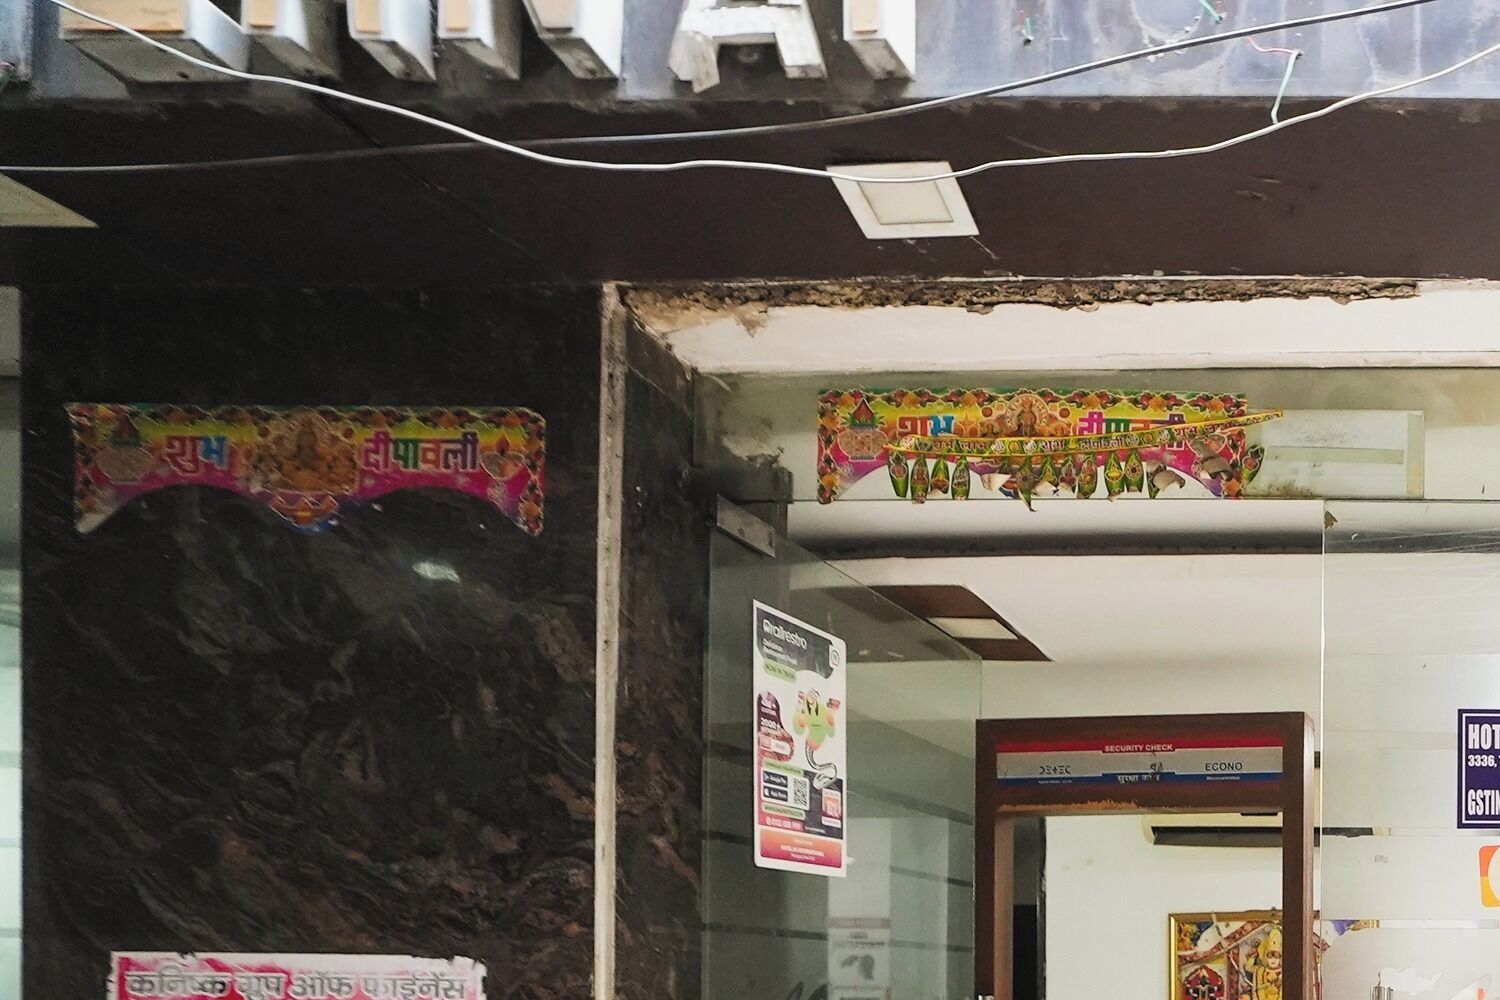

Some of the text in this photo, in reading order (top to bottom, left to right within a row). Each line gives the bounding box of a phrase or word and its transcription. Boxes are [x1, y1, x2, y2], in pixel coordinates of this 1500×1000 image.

[164, 430, 480, 475] शुभ दीपावली
[1145, 744, 1173, 752] CHECK
[1205, 762, 1243, 771] ECONO
[1467, 754, 1497, 768] 3336,
